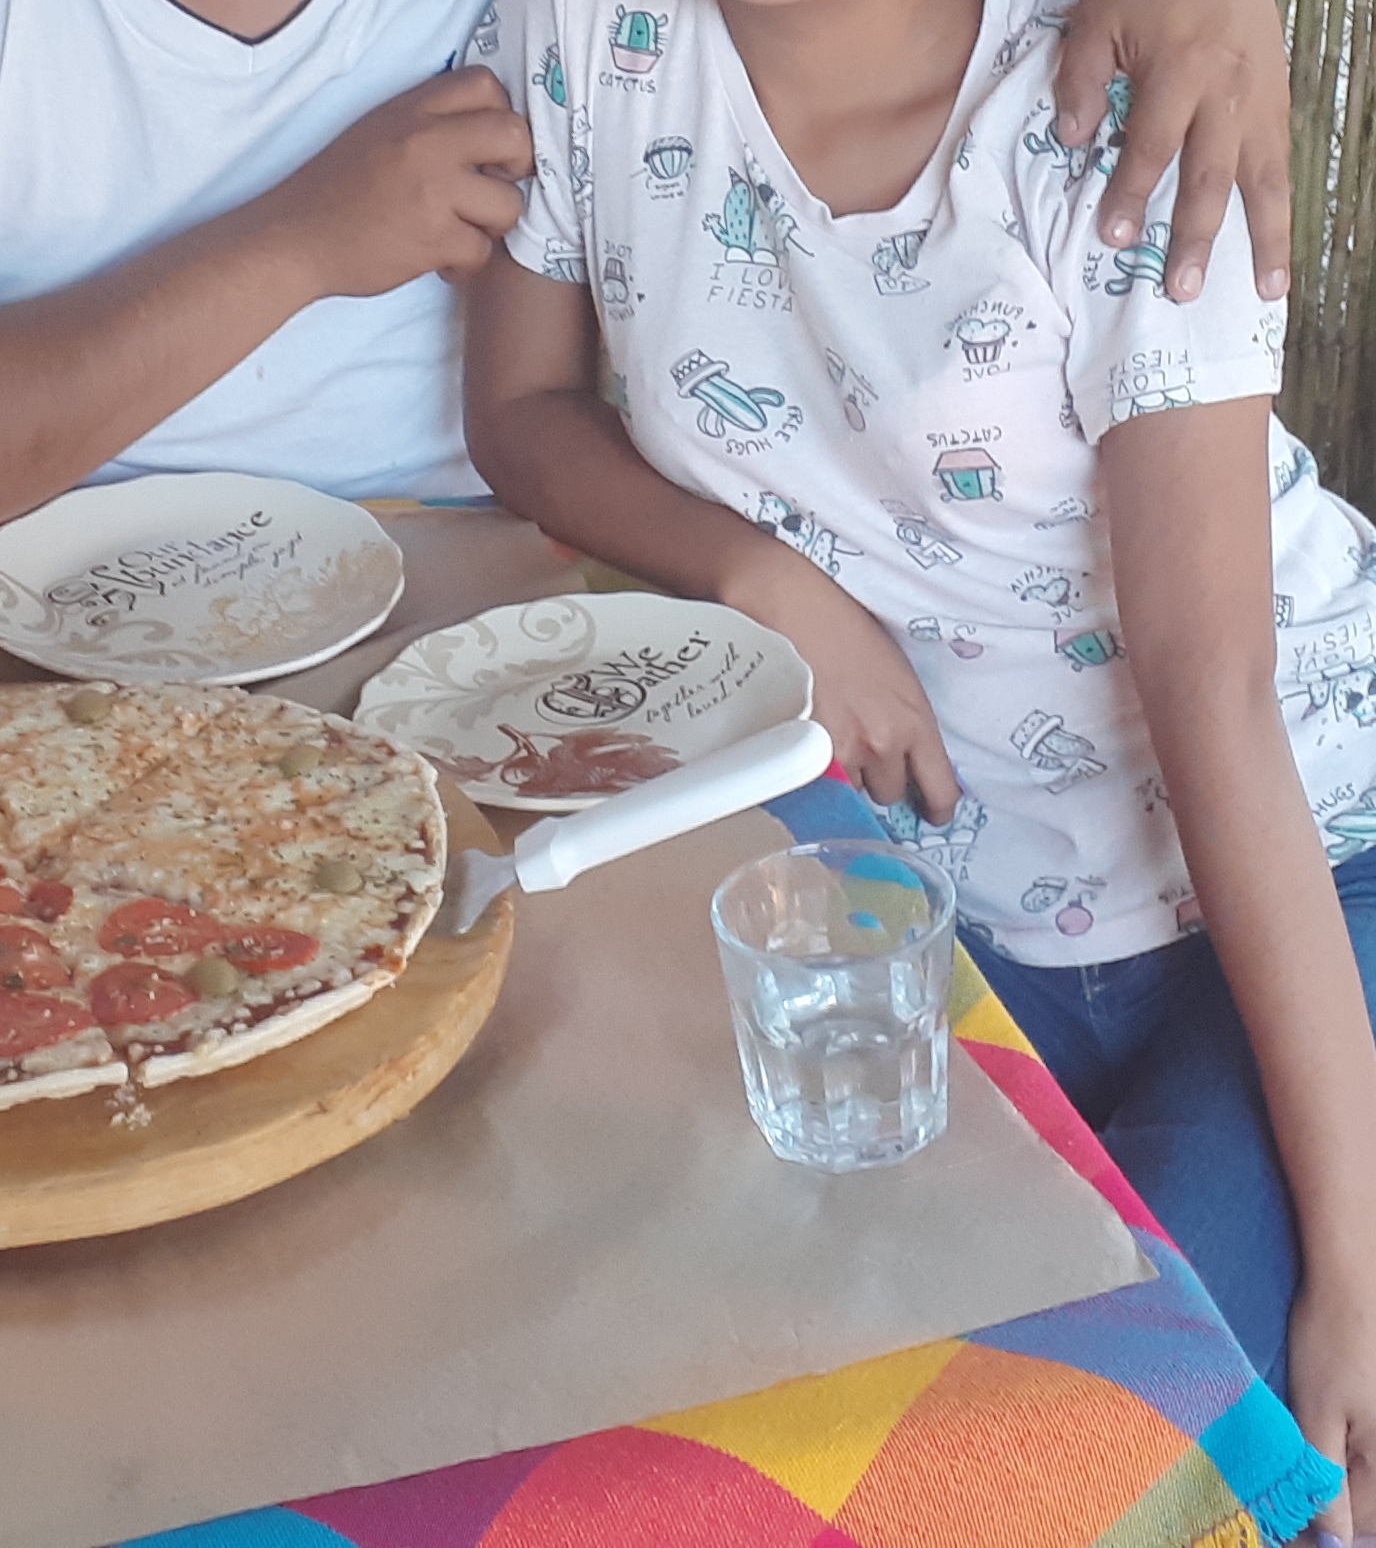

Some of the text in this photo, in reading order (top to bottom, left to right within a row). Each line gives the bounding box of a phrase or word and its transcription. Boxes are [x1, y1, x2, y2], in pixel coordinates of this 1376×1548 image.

[598, 70, 657, 95] CATCTUS
[709, 262, 726, 282] I
[1081, 250, 1104, 292] FREE
[707, 284, 794, 313] FIESTA
[774, 404, 804, 443] FREE
[926, 425, 1003, 448] CATCTUS
[725, 437, 773, 456] HUGS
[589, 645, 664, 678] We
[1312, 781, 1356, 818] HUGS
